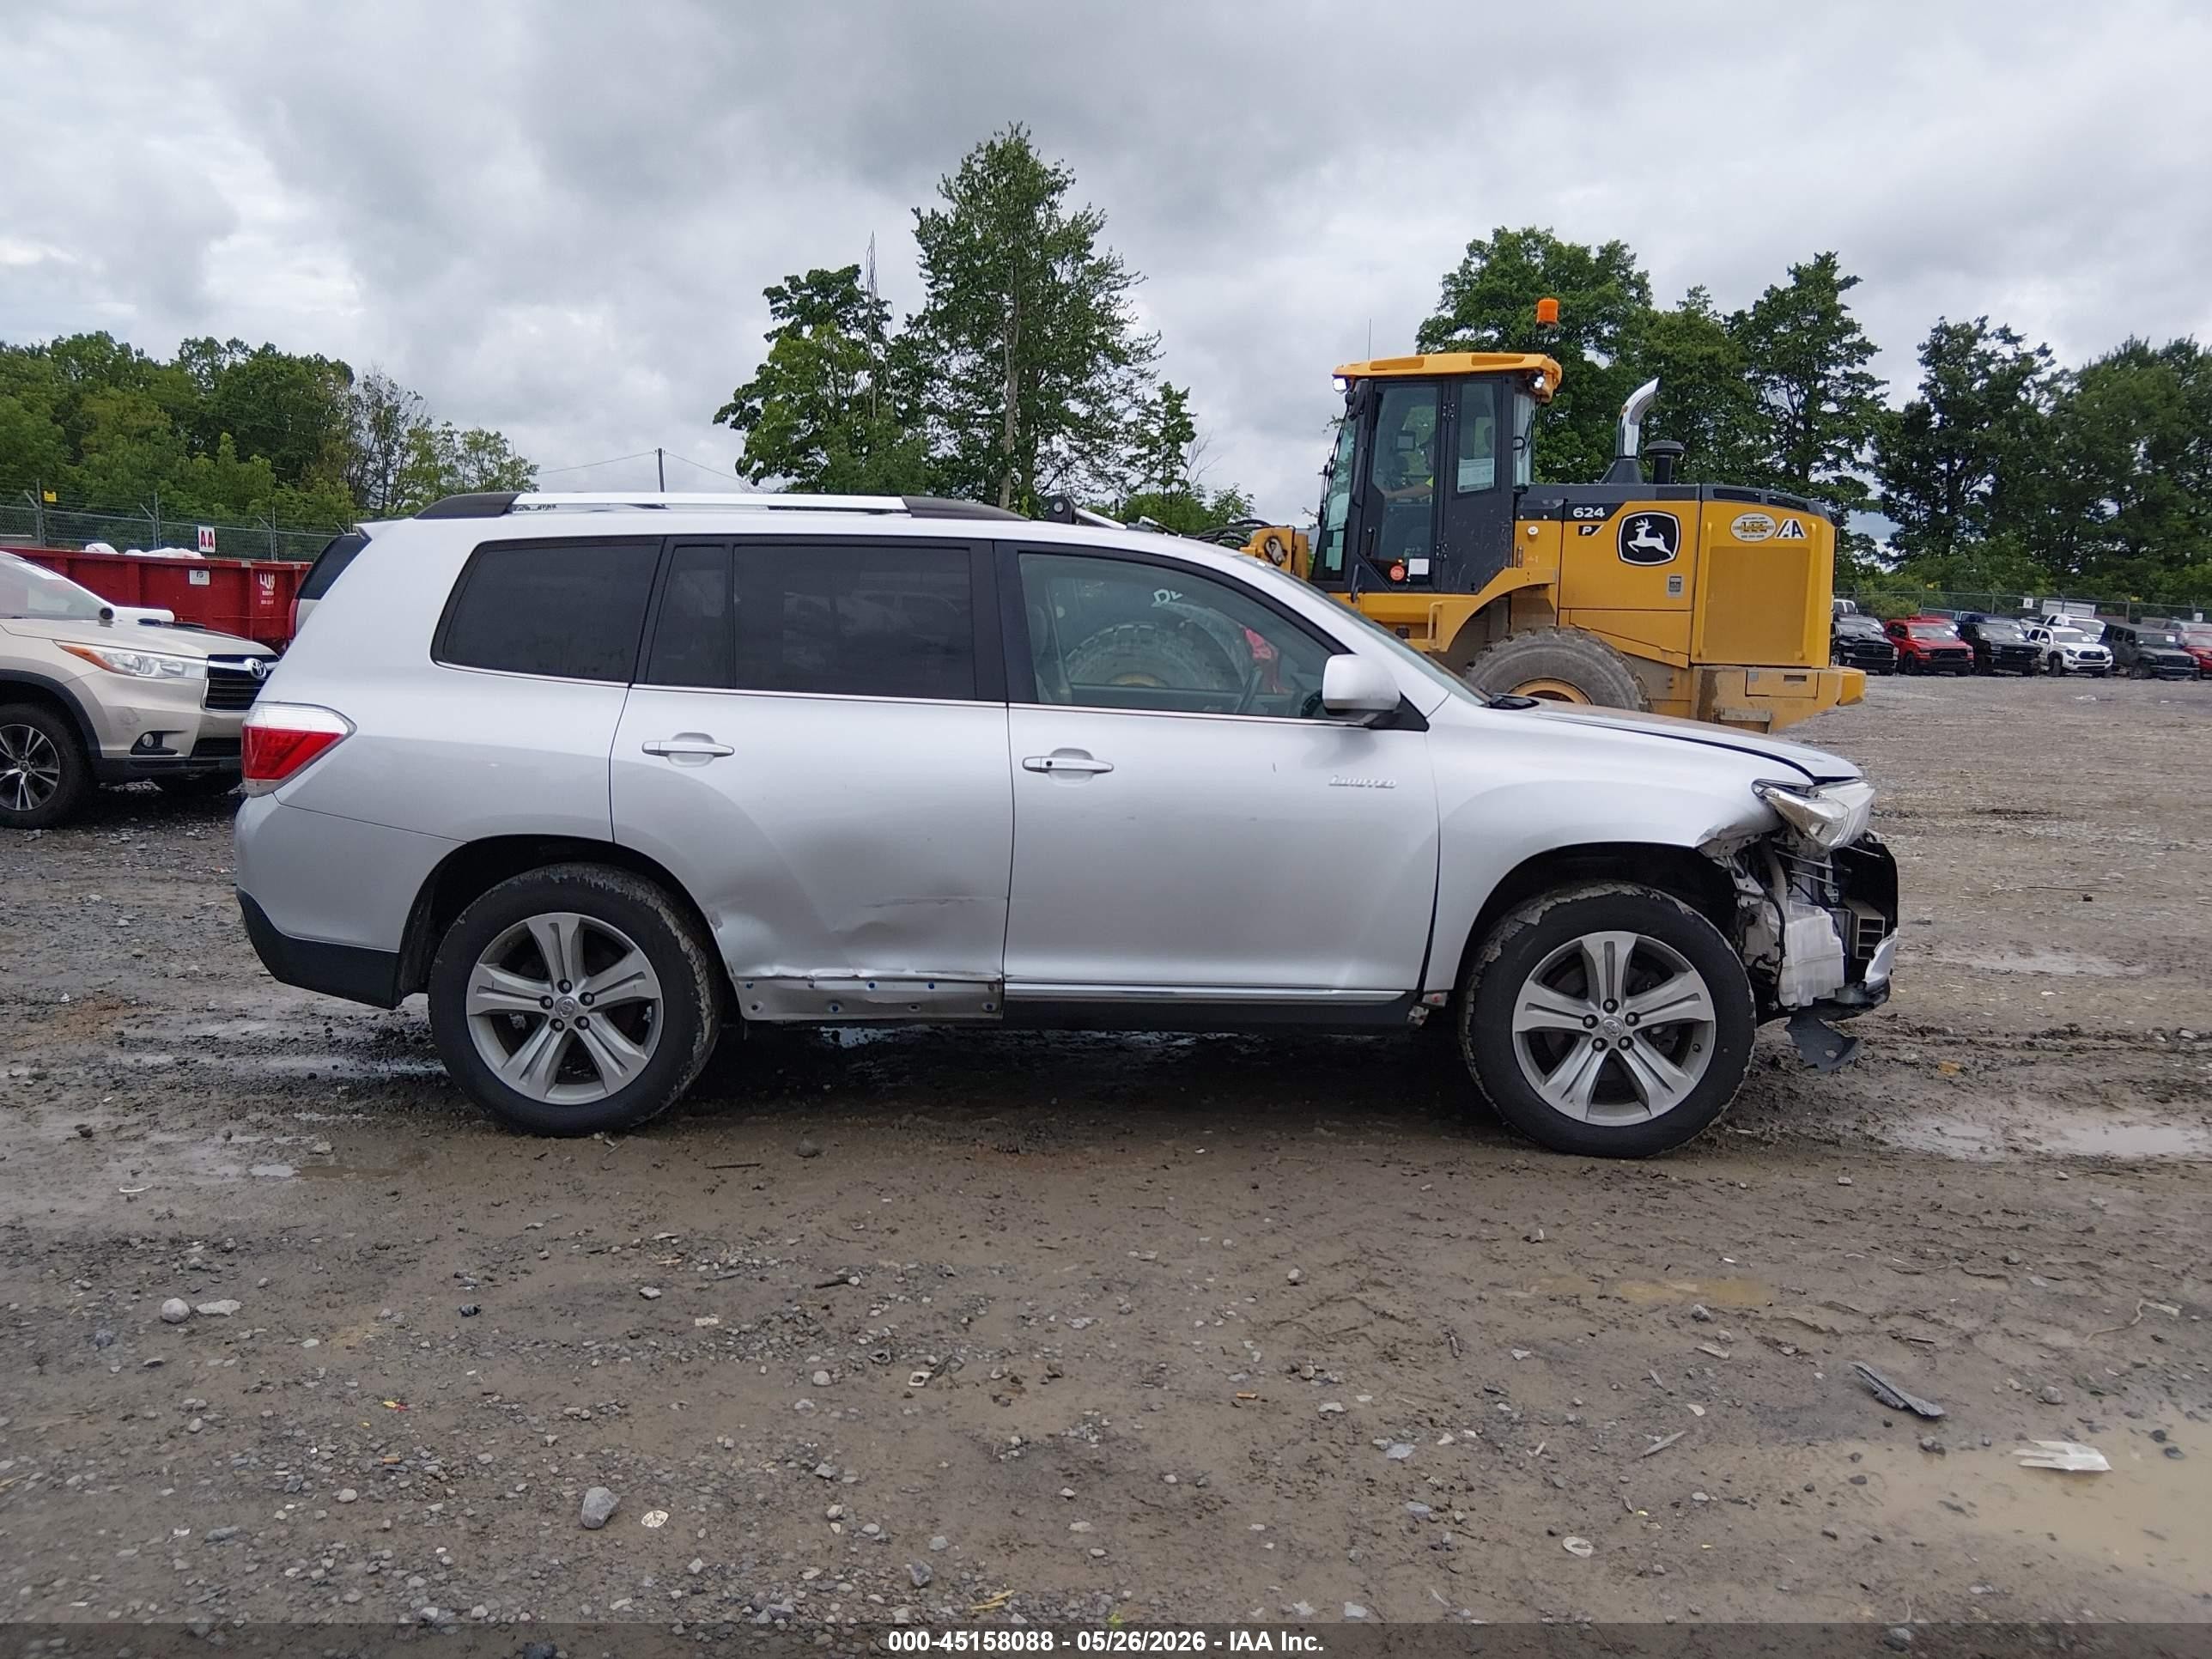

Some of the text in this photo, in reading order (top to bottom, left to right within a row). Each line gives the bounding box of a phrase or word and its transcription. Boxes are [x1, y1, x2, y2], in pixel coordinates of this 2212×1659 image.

[1573, 507, 1606, 519] 624
[1582, 526, 1593, 536] P
[200, 530, 215, 549] AA
